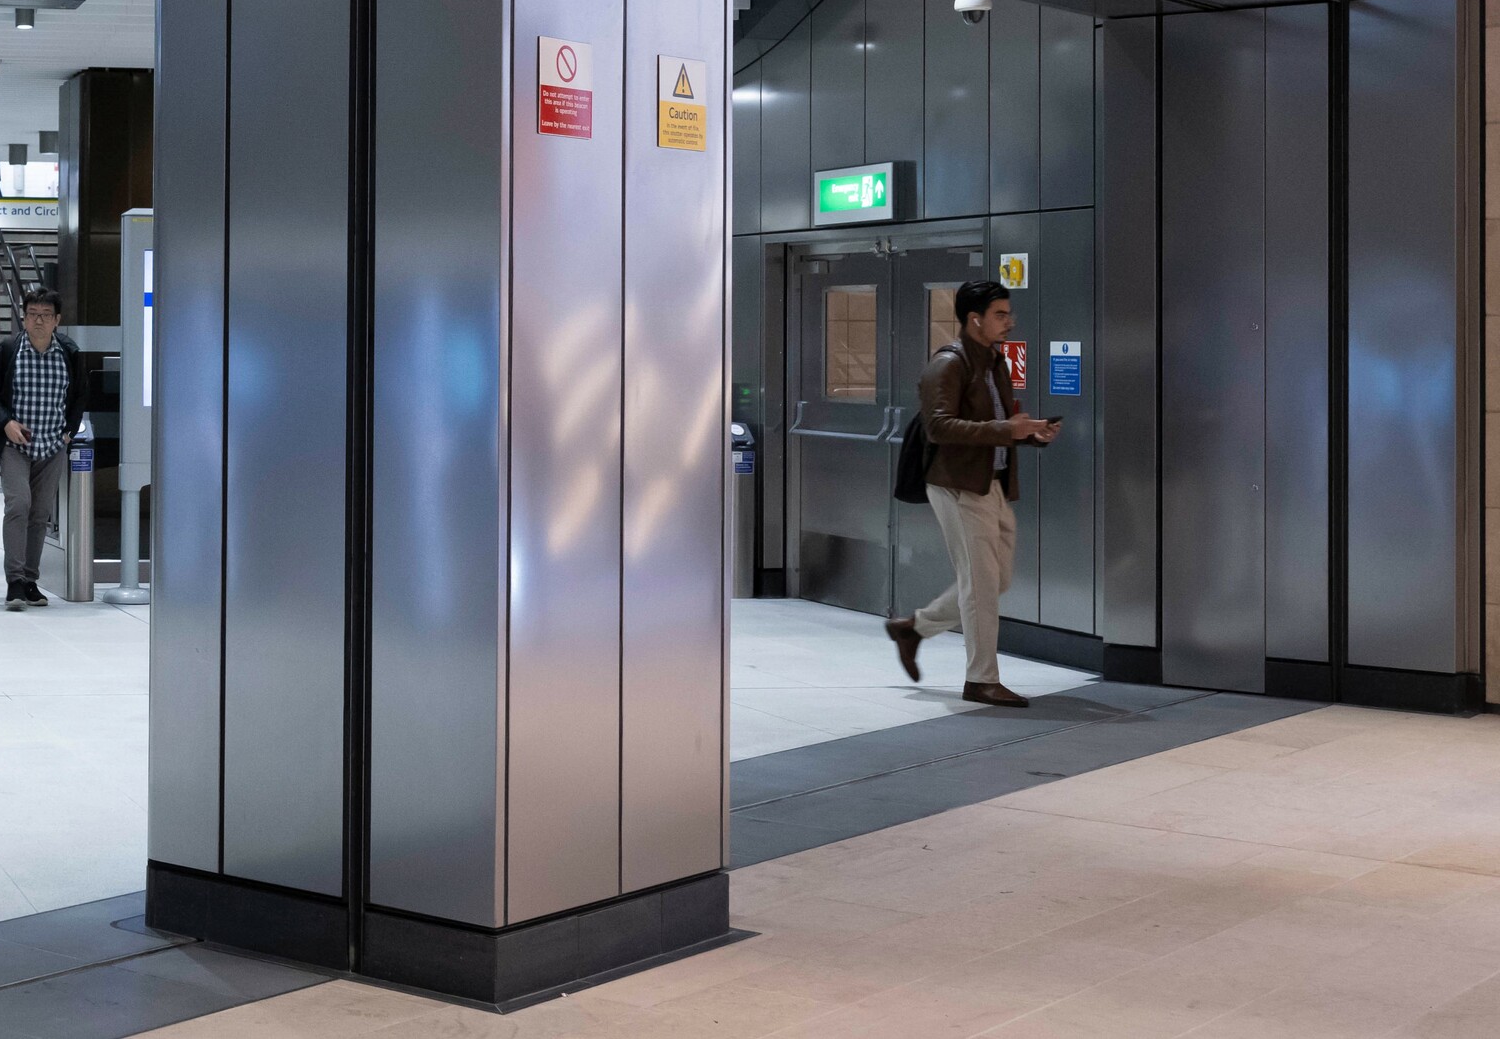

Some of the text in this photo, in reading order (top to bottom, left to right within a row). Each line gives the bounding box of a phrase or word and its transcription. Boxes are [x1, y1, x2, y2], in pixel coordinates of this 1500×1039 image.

[669, 107, 698, 121] Caution
[11, 206, 31, 215] and
[35, 206, 59, 216] Circl
